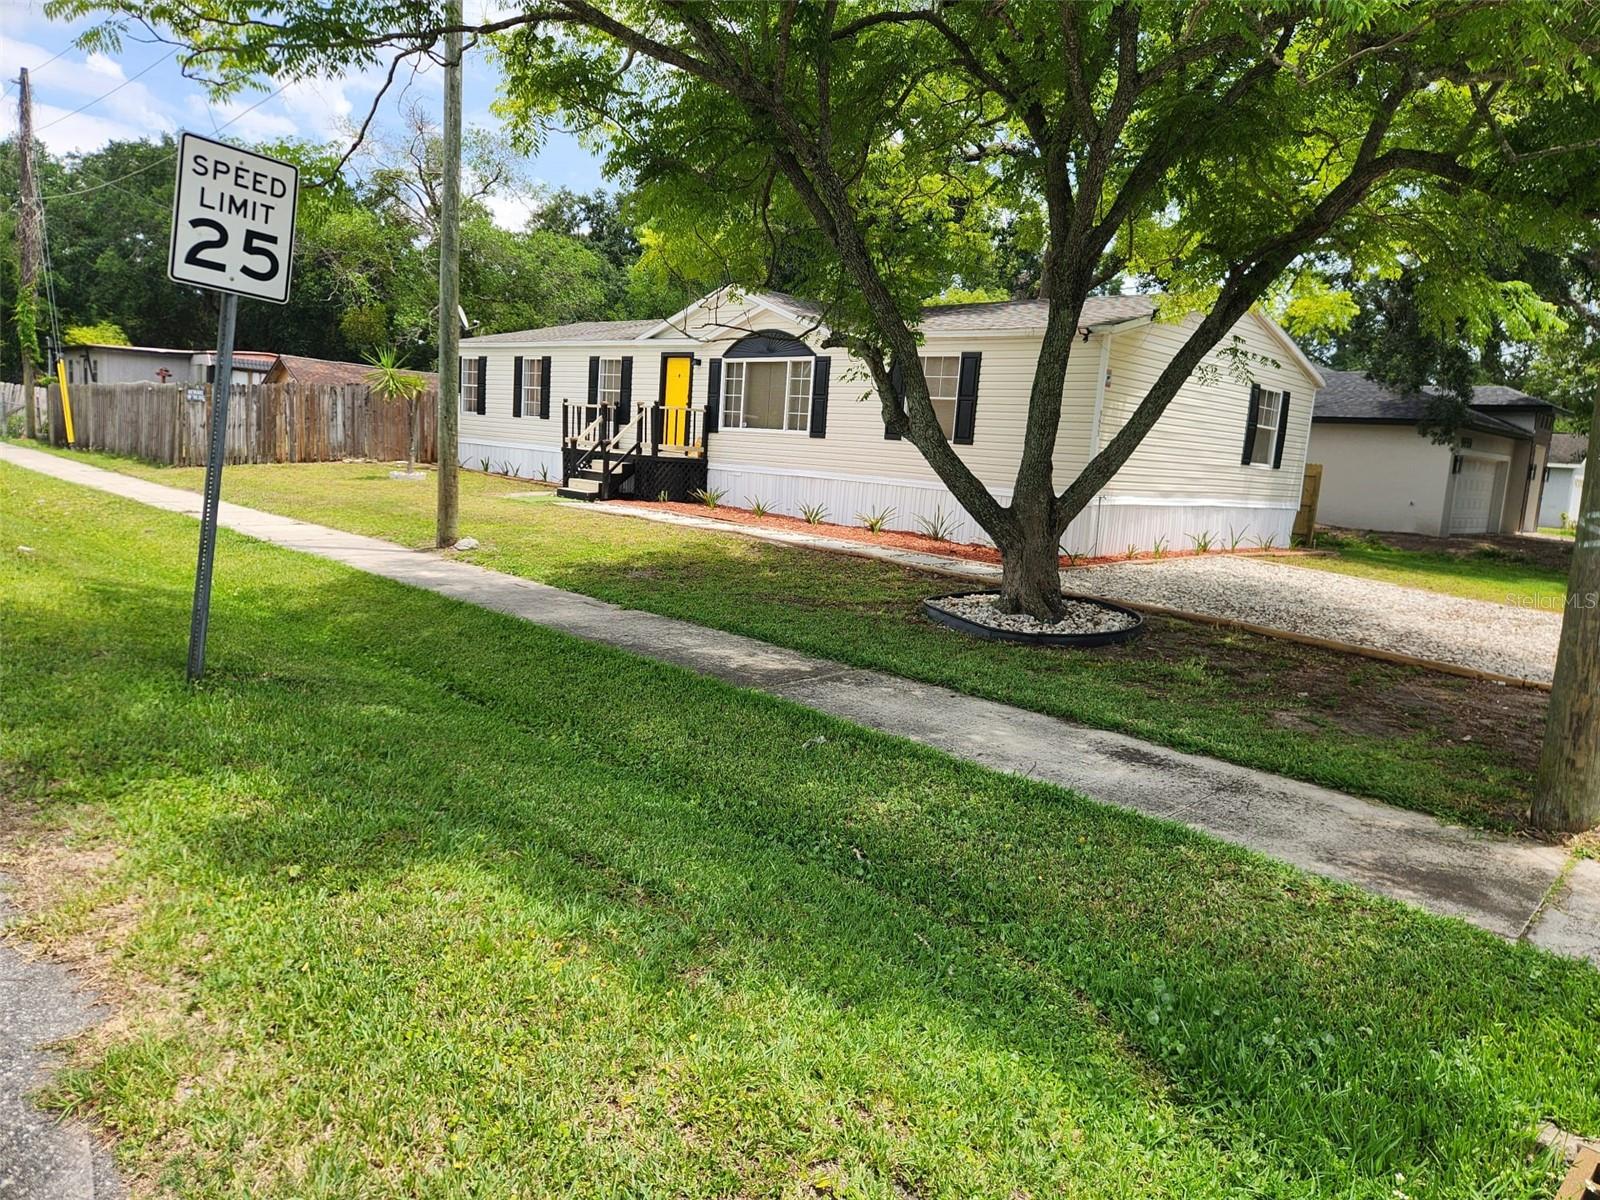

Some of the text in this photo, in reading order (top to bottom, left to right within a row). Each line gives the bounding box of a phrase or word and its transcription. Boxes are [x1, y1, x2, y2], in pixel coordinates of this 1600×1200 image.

[192, 155, 286, 199] SPEED
[199, 186, 275, 224] LIMIT
[184, 217, 279, 281] 25
